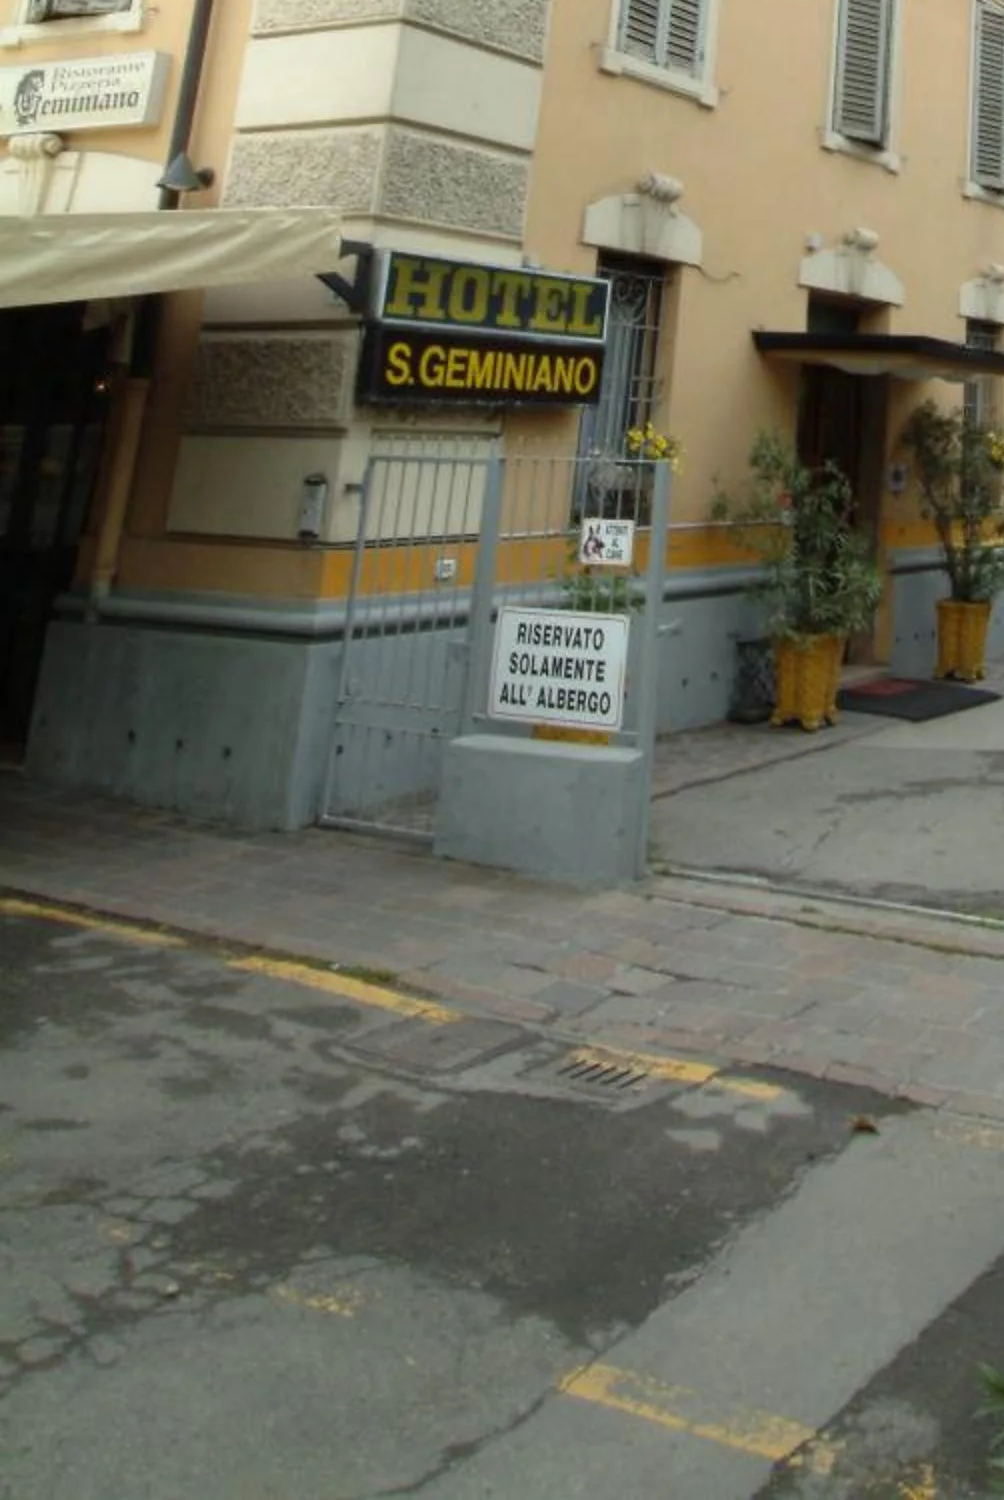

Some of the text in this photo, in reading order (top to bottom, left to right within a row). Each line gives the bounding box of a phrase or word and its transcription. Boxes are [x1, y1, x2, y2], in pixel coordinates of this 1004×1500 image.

[383, 257, 601, 337] HOTEL
[385, 343, 597, 395] S. GEMINIANO
[517, 622, 605, 651] RISERVATO
[509, 652, 606, 682] SOLAMENTE
[500, 683, 611, 715] ALL' ALBERGO
